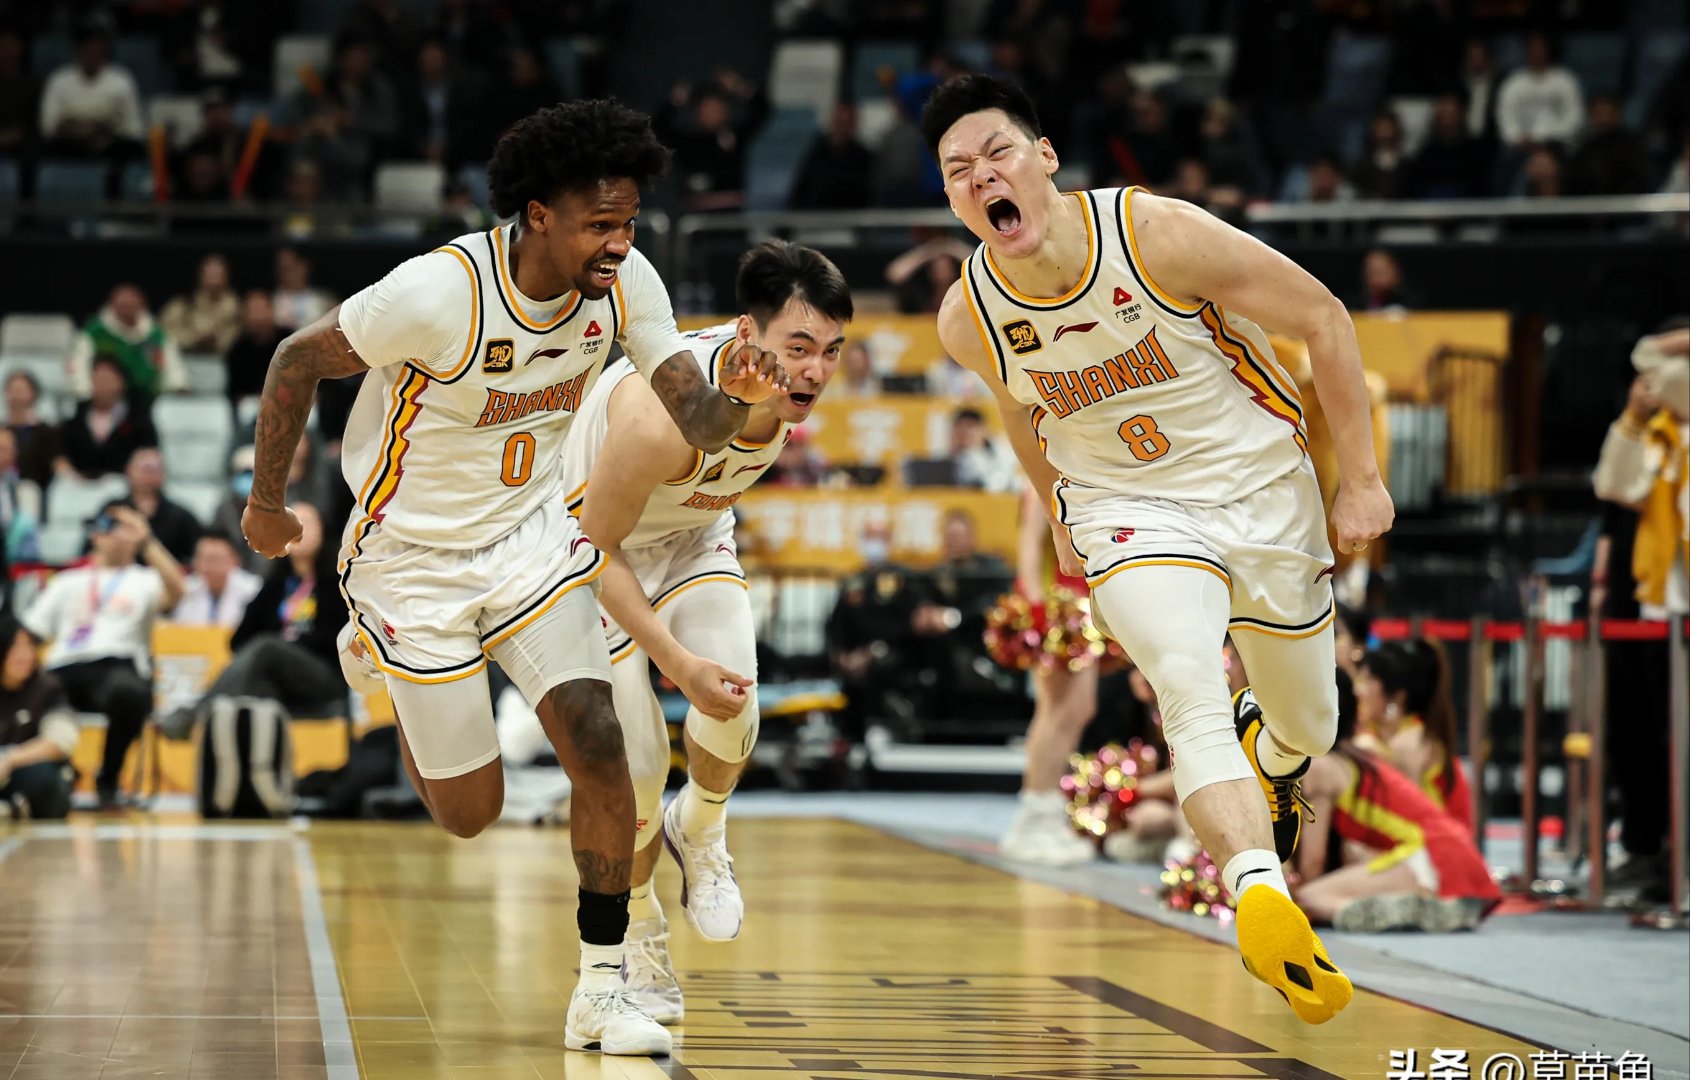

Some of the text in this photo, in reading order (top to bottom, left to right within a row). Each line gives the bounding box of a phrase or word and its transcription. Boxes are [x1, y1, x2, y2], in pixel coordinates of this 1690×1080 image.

[1123, 312, 1141, 324] CGB
[583, 346, 599, 355] CGB
[1021, 324, 1180, 420] SHANXI
[473, 361, 597, 428] SHANXI
[500, 432, 536, 487] 0
[1117, 414, 1171, 462] 8
